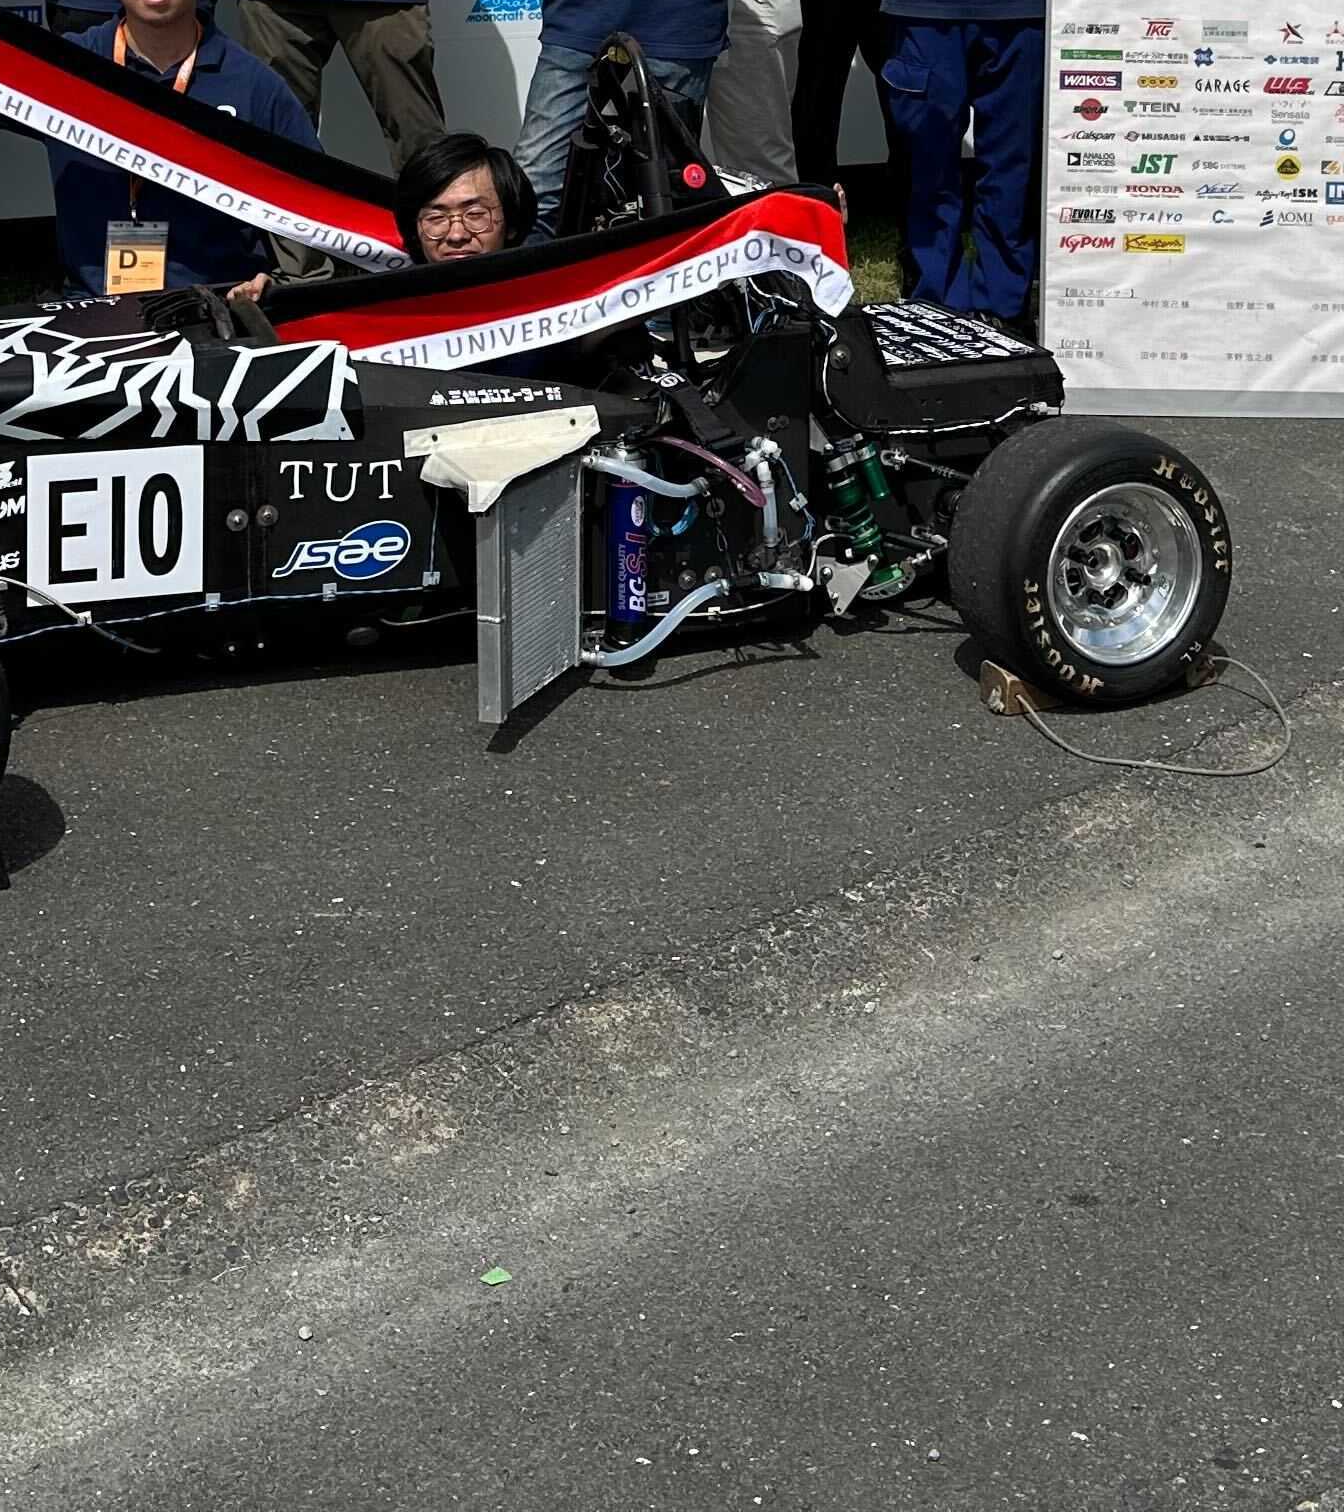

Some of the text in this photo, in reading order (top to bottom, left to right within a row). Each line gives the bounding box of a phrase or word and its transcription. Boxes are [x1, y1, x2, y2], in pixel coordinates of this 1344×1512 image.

[1195, 78, 1252, 93] GARAGE
[1139, 101, 1182, 114] TEIN
[46, 114, 211, 198] UNIVERSITY
[215, 190, 254, 217] OF
[1130, 153, 1179, 175] JST
[1125, 184, 1185, 194] HONDA
[118, 248, 139, 270] D
[446, 295, 609, 359] UNIVERSITY
[621, 282, 657, 310] OF
[279, 458, 403, 503] TUT
